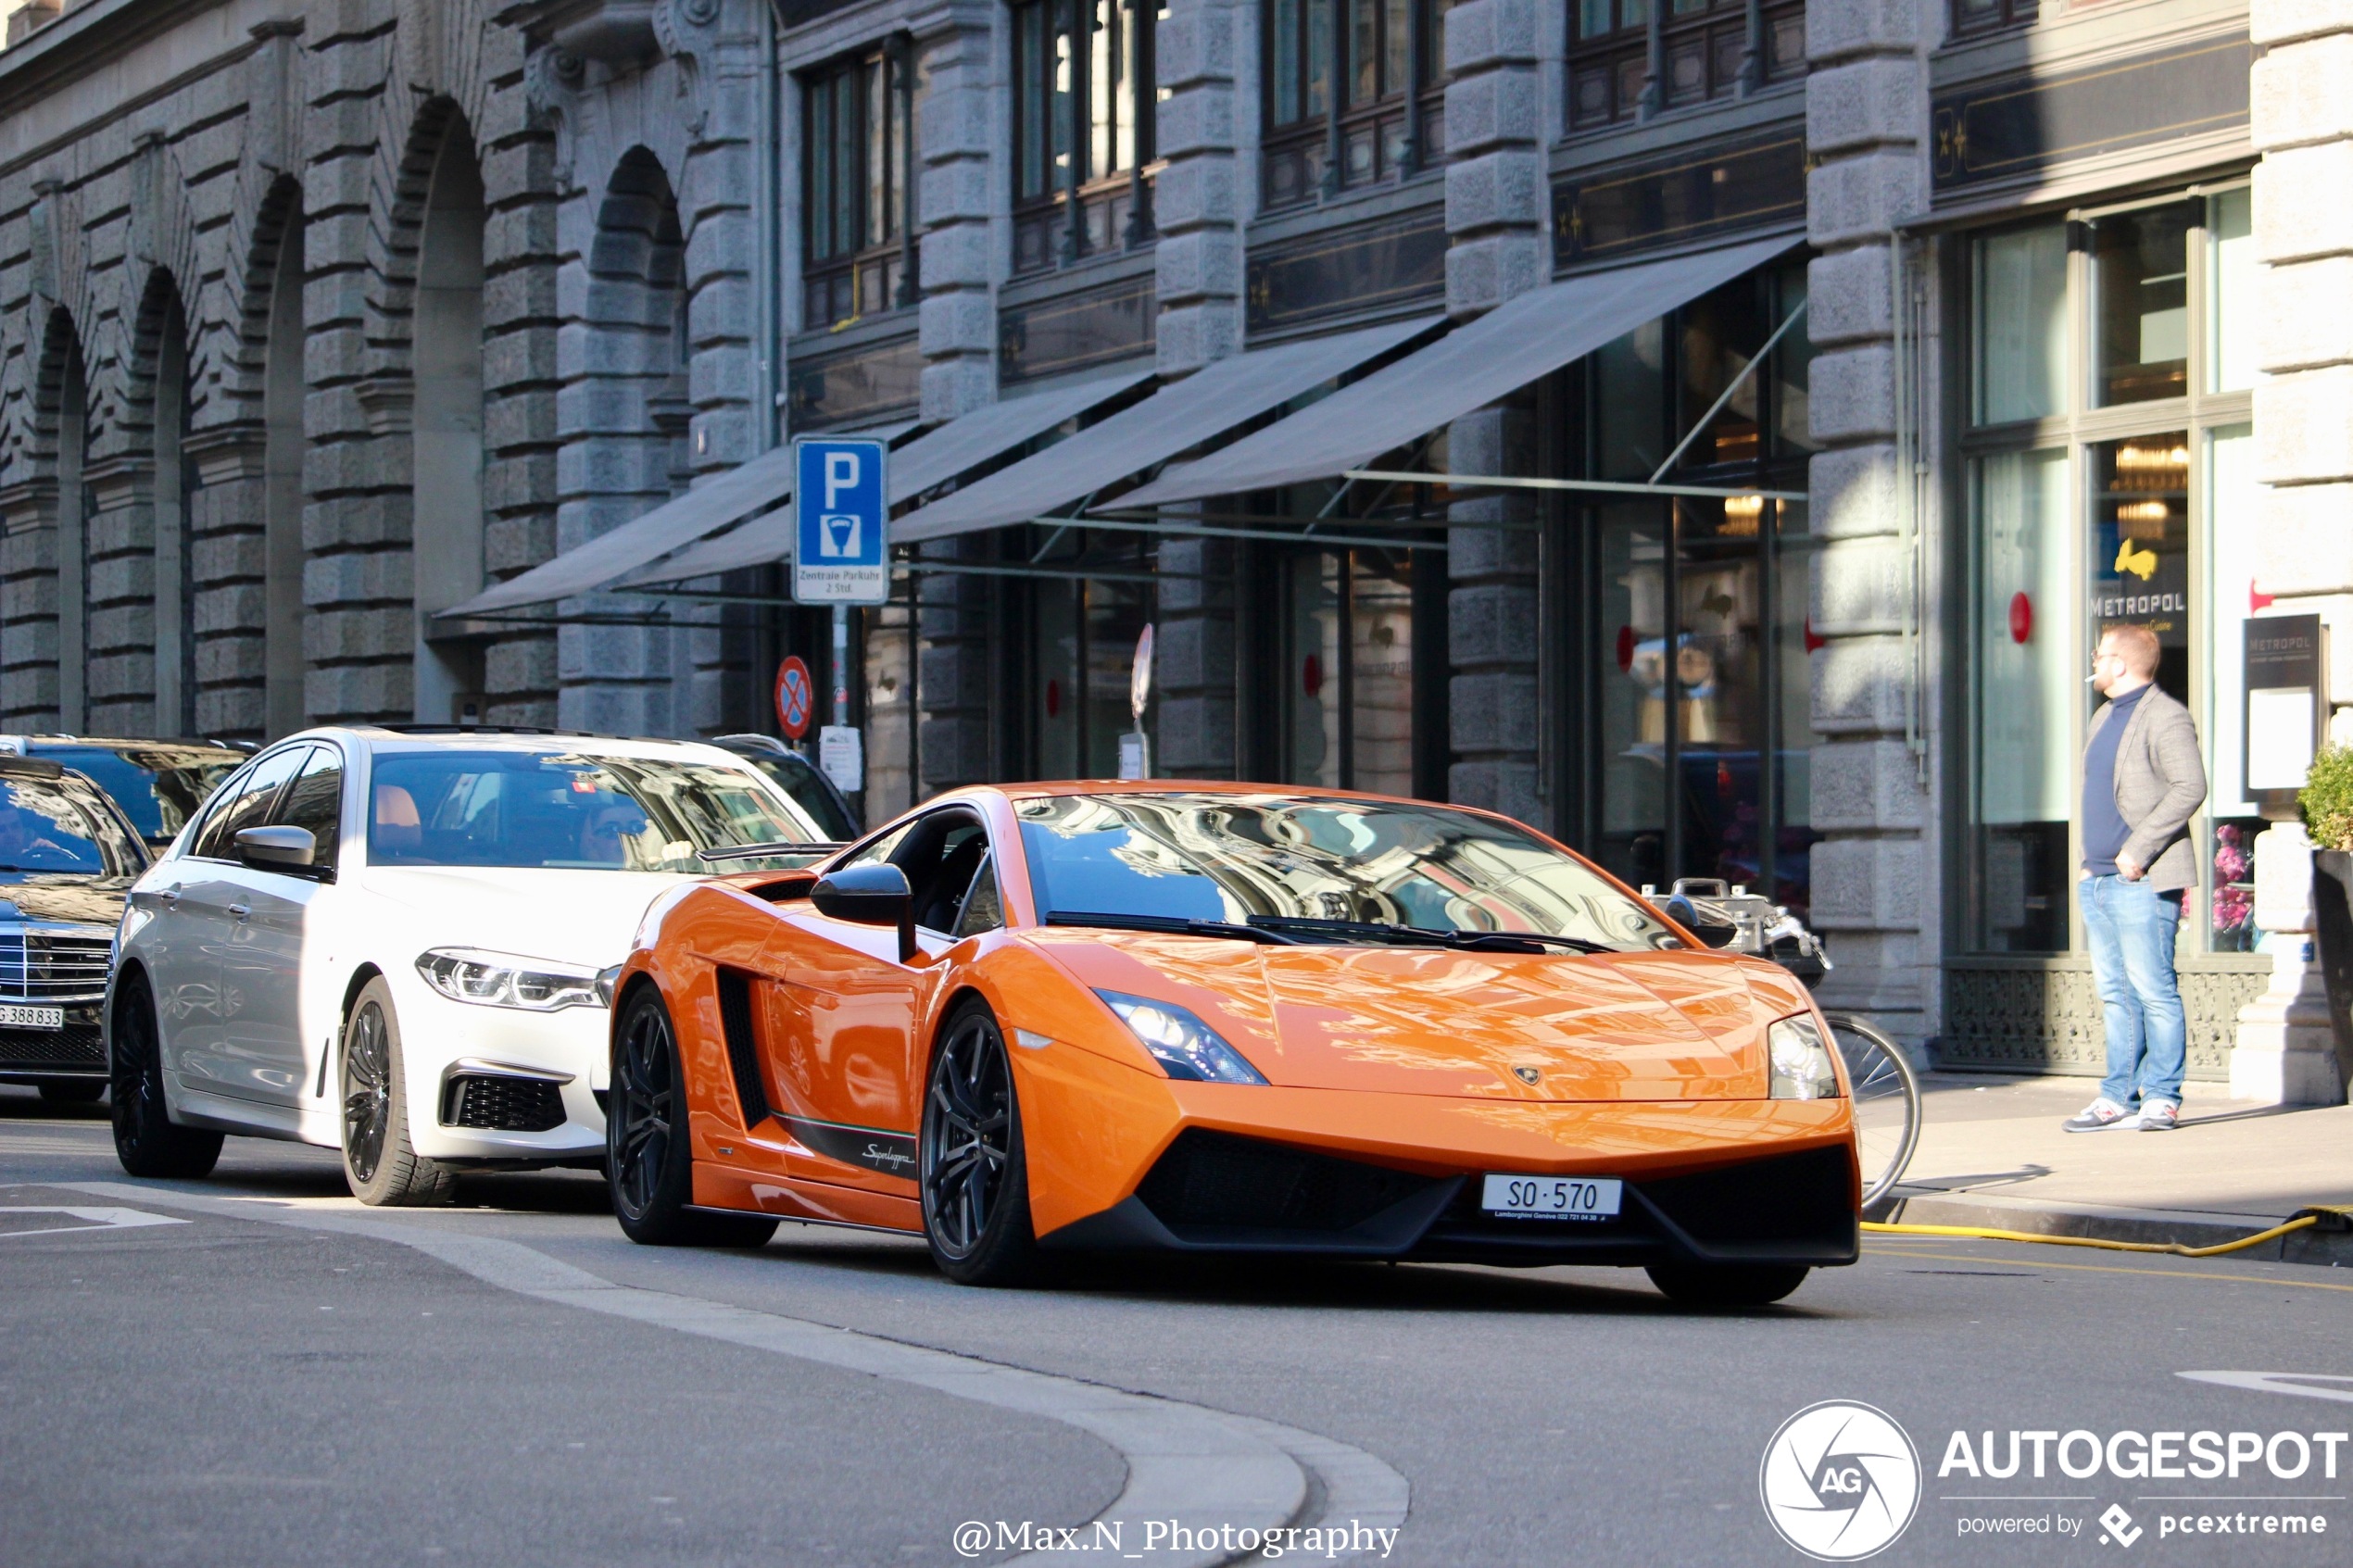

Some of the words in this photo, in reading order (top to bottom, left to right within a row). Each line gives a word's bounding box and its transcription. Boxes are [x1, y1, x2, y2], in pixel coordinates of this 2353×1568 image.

[824, 452, 860, 509] P
[843, 571, 880, 581] Parkuhr
[825, 583, 832, 593] 2
[2089, 593, 2186, 618] METROPOL
[2249, 636, 2310, 651] METROPOL
[862, 1143, 915, 1170] Superleggera
[1494, 1210, 1532, 1219] Lamborghini
